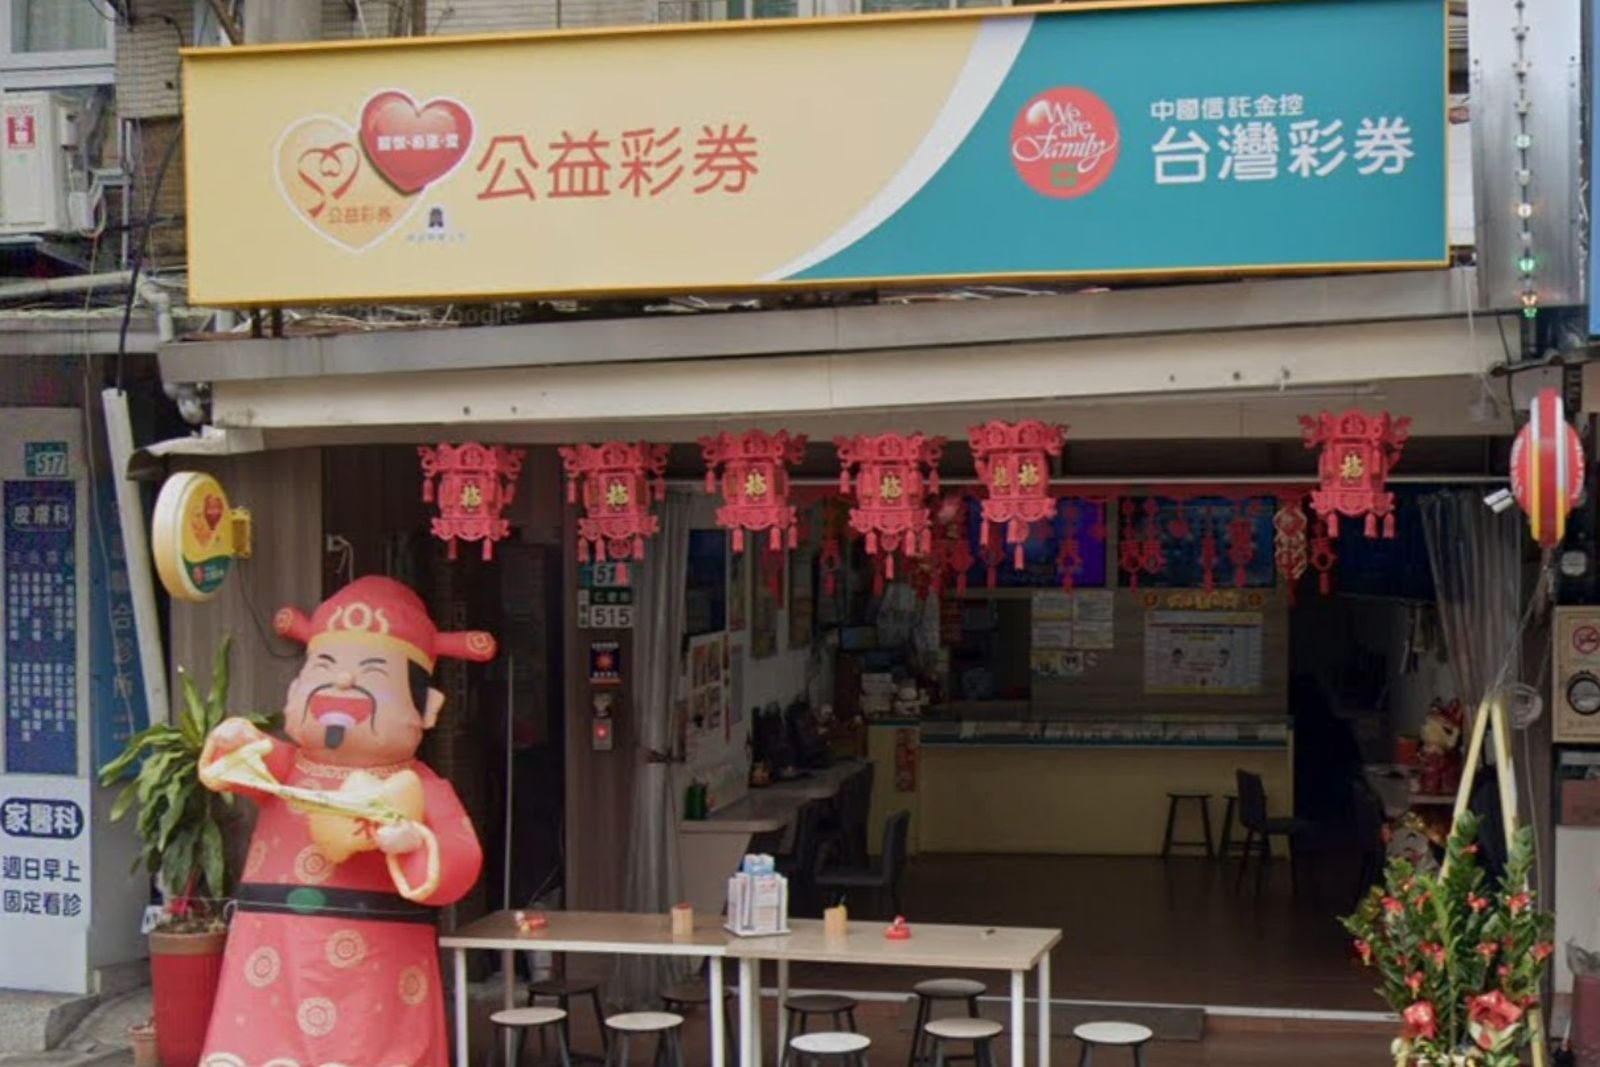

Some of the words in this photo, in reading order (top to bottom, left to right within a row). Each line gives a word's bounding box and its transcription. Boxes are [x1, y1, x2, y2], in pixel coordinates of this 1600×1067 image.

[1150, 94, 1305, 120] 中國信託金控
[476, 123, 759, 202] 公益彩券
[1151, 116, 1415, 184] 台灣彩券
[328, 206, 393, 223] 公益彩券
[36, 453, 65, 474] 517
[595, 607, 631, 626] 515
[4, 802, 79, 836] 家醫科
[3, 855, 82, 882] 週日早上
[4, 889, 82, 917] 固定看診
